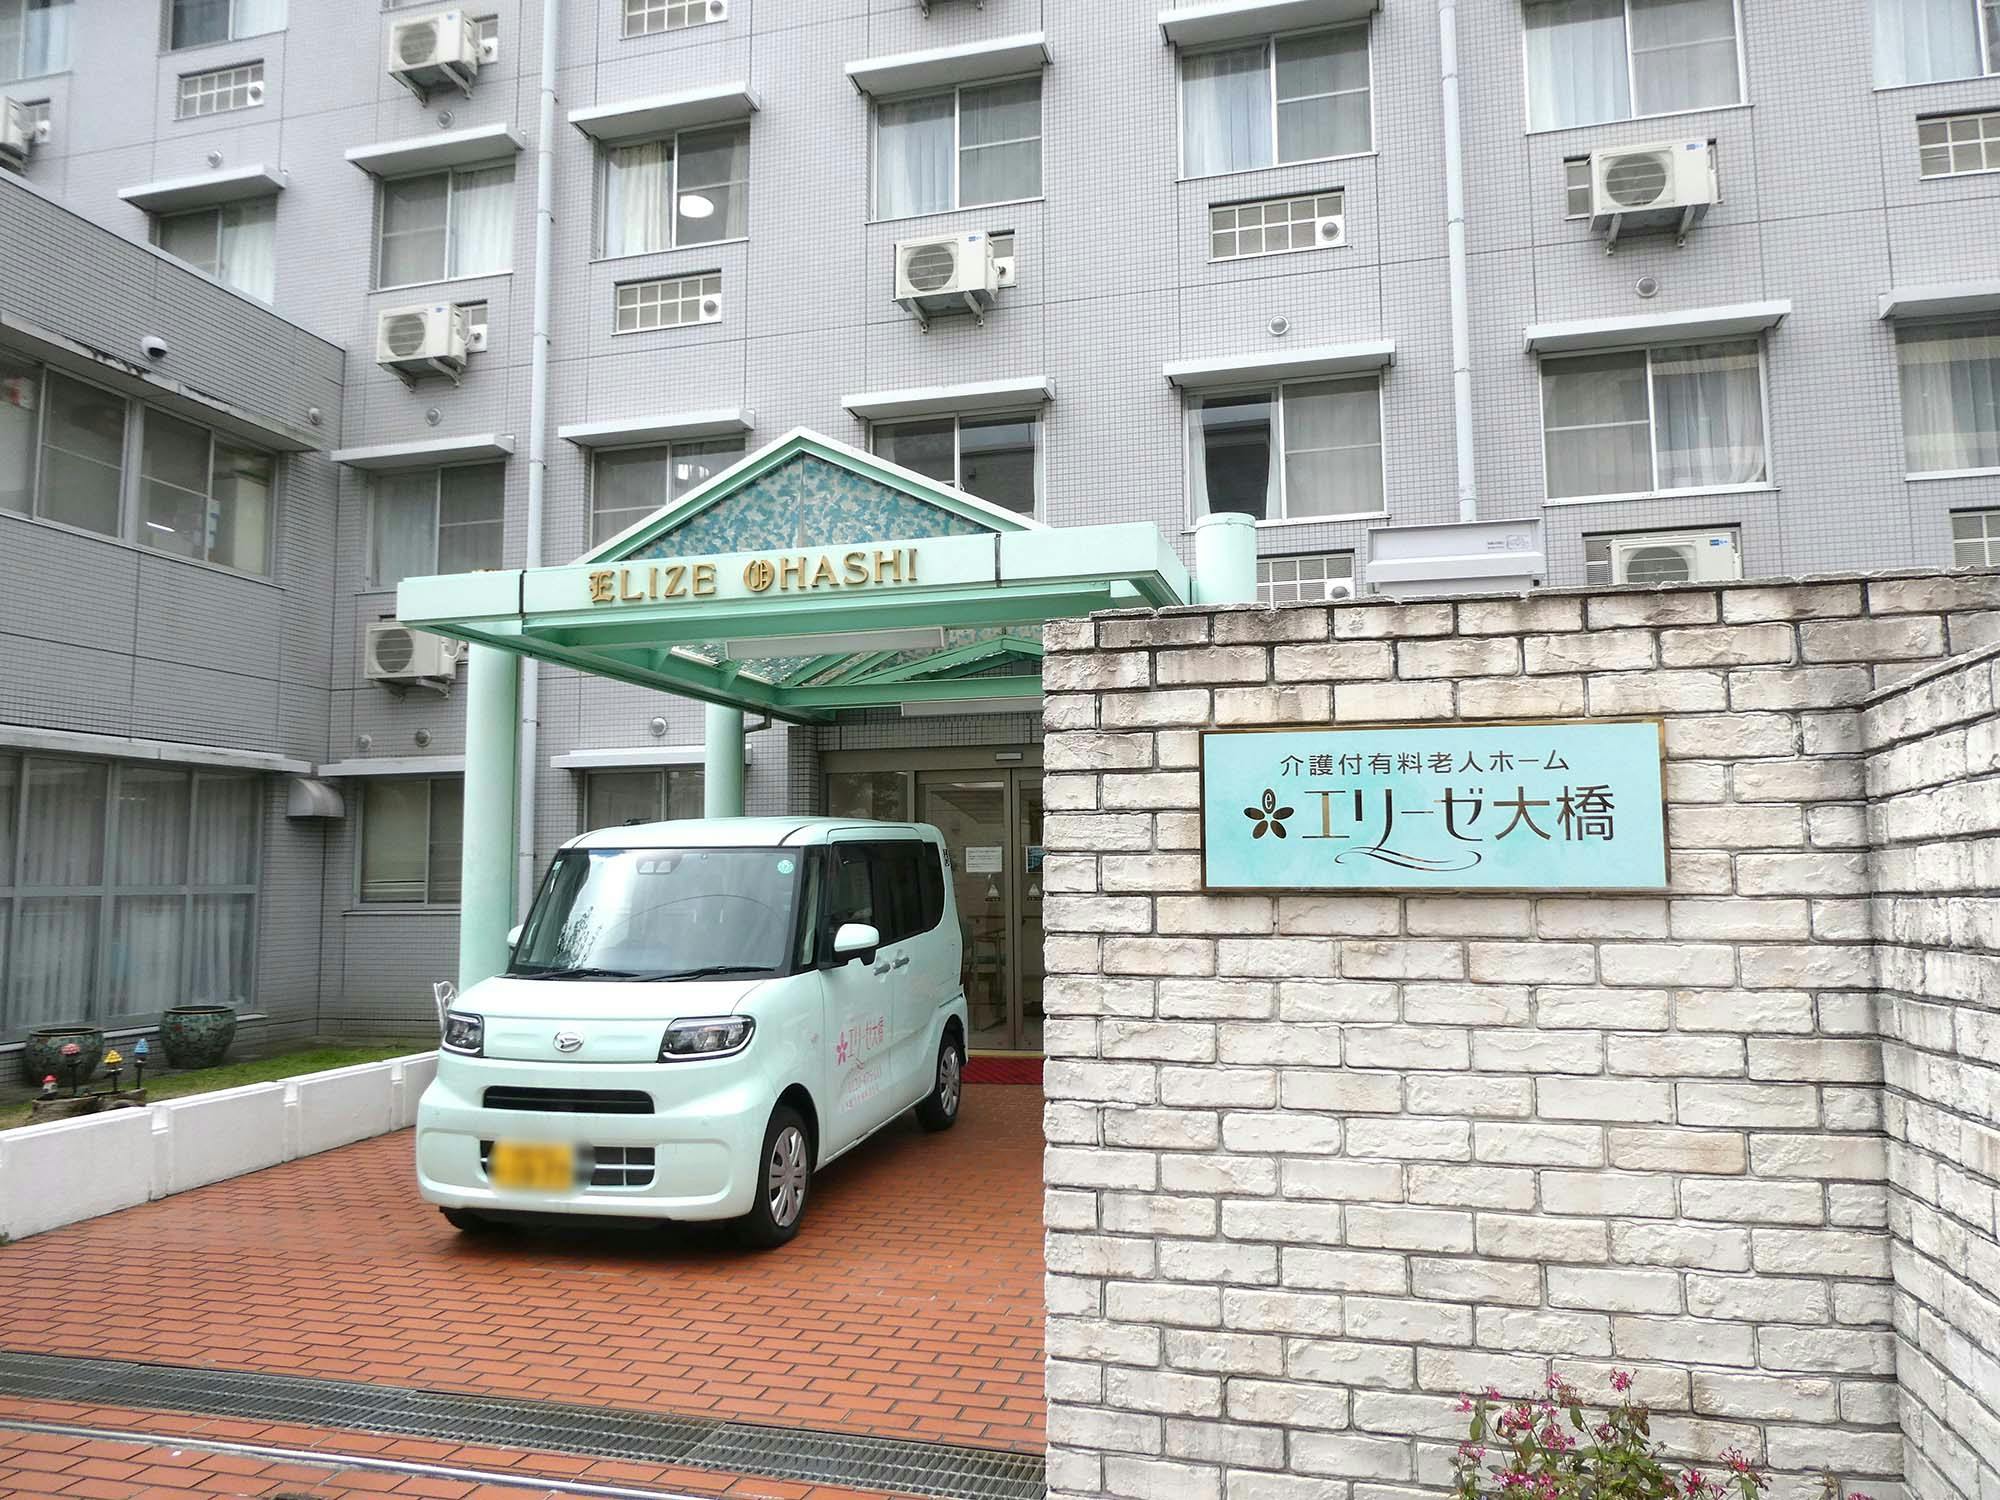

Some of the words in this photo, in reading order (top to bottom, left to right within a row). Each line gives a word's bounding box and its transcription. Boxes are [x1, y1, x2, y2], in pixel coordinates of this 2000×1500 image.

[588, 562, 717, 604] ELIZE
[743, 548, 919, 593] OHASHI
[1279, 749, 1571, 777] 介護付有料老人ホーム
[1301, 784, 1616, 846] エリーゼ大橋
